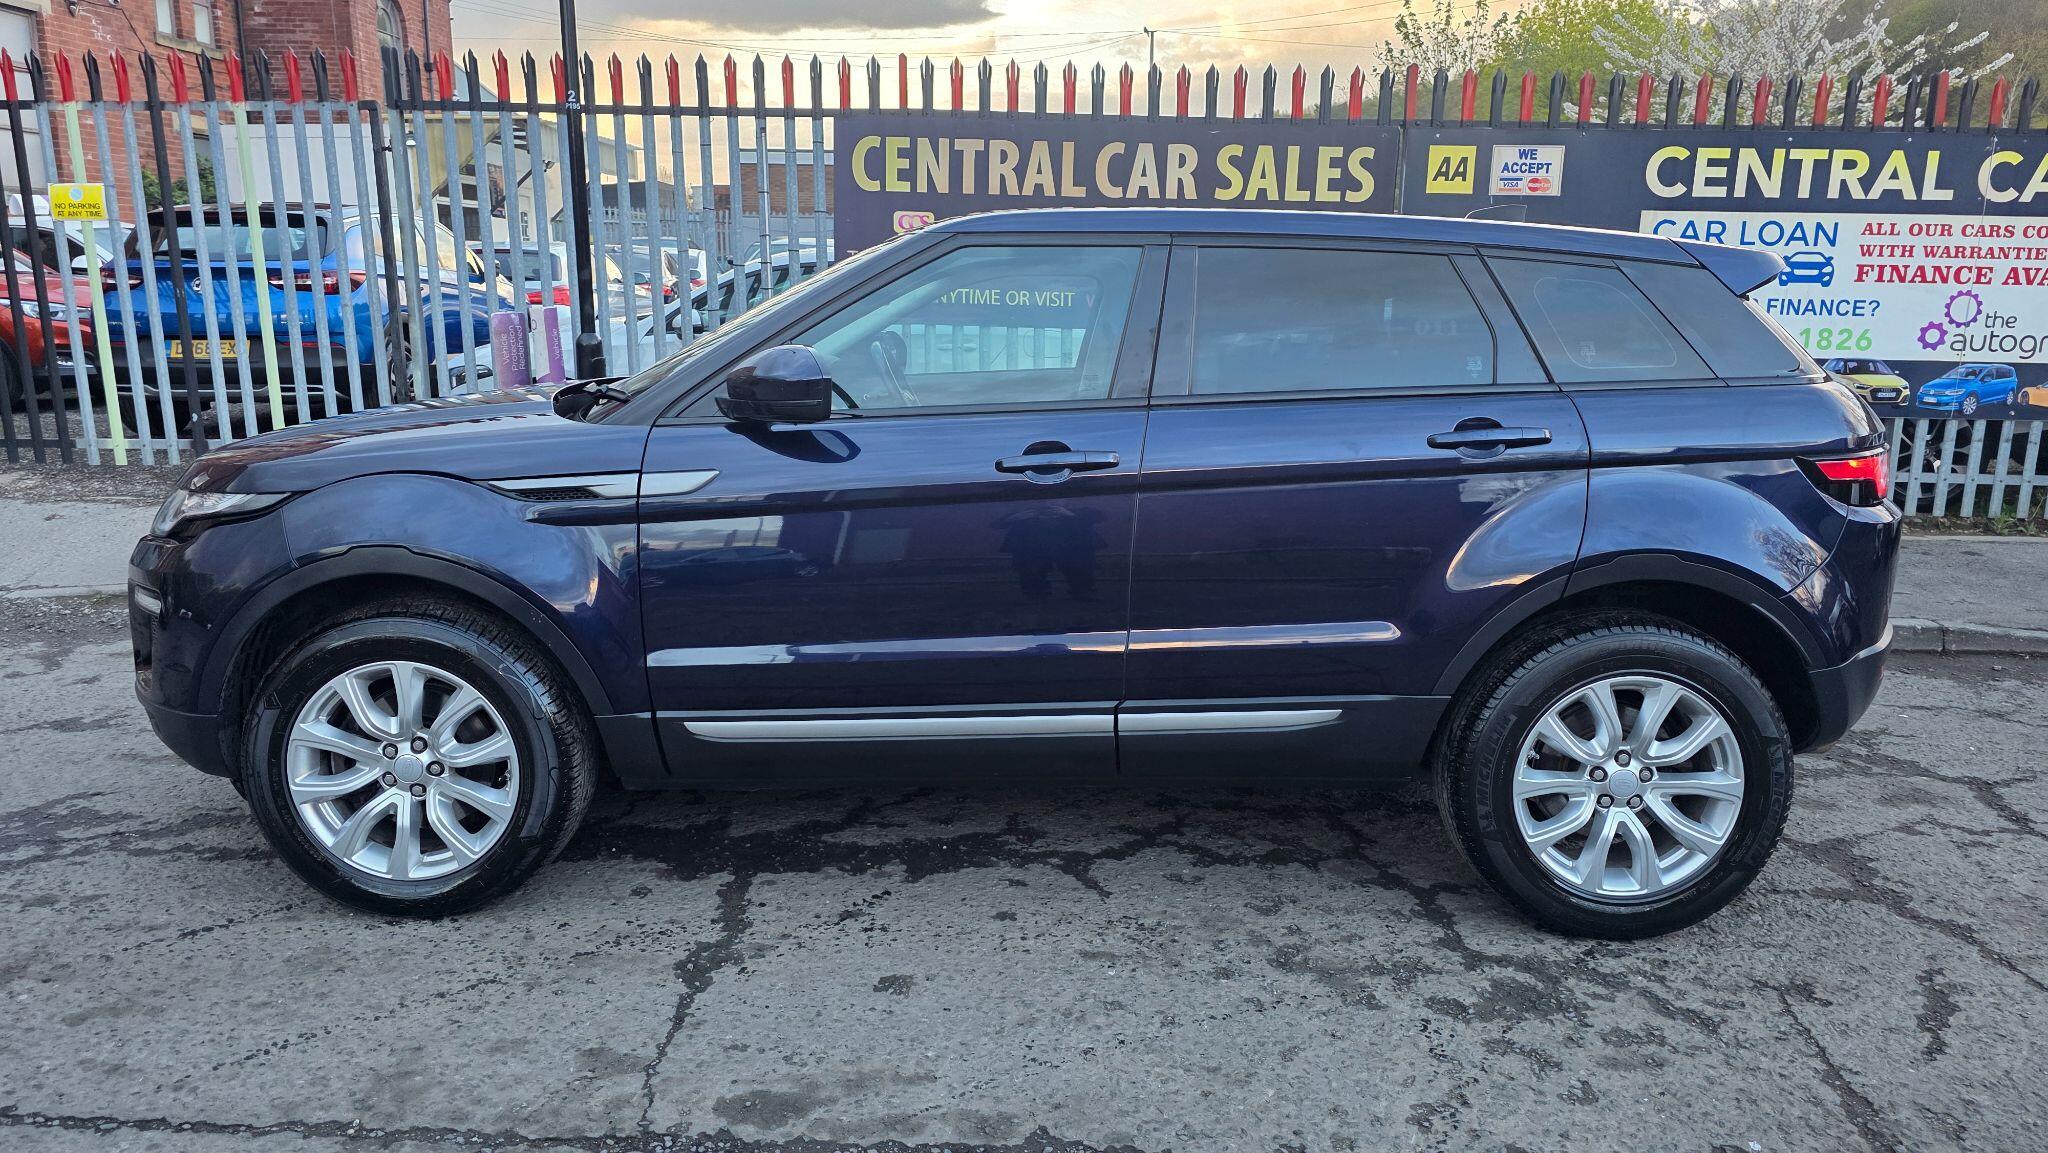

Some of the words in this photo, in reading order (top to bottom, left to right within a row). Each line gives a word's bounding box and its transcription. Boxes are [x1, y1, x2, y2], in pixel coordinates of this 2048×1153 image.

[567, 89, 576, 102] 2
[1518, 149, 1539, 160] WE
[851, 135, 1087, 198] CENTRAL
[1095, 141, 1199, 200] CAR
[1213, 143, 1376, 203] SALES
[1431, 156, 1469, 182] AA
[1501, 162, 1553, 174] ACCEPT
[1645, 145, 1954, 201] CENTRAL
[54, 202, 66, 210] NO
[68, 202, 101, 210] PARKING
[1740, 220, 1839, 247] LOAN
[1861, 222, 1901, 236] ALL
[1908, 223, 1954, 237] OUR
[1961, 224, 2016, 239] CARS
[1859, 244, 1916, 258] WITH
[1923, 245, 2047, 262] WARRANTIE
[1854, 264, 1995, 285] FINANCE
[1005, 290, 1030, 306] OR
[1035, 291, 1076, 307] VISIT
[1766, 298, 1881, 317] FINANCE?
[1985, 310, 2017, 328] the
[501, 333, 510, 366] Vehicle
[508, 325, 519, 371] Protection
[551, 328, 560, 360] Vehicle
[1799, 327, 1873, 351] 1826
[1950, 331, 2048, 359] autogr
